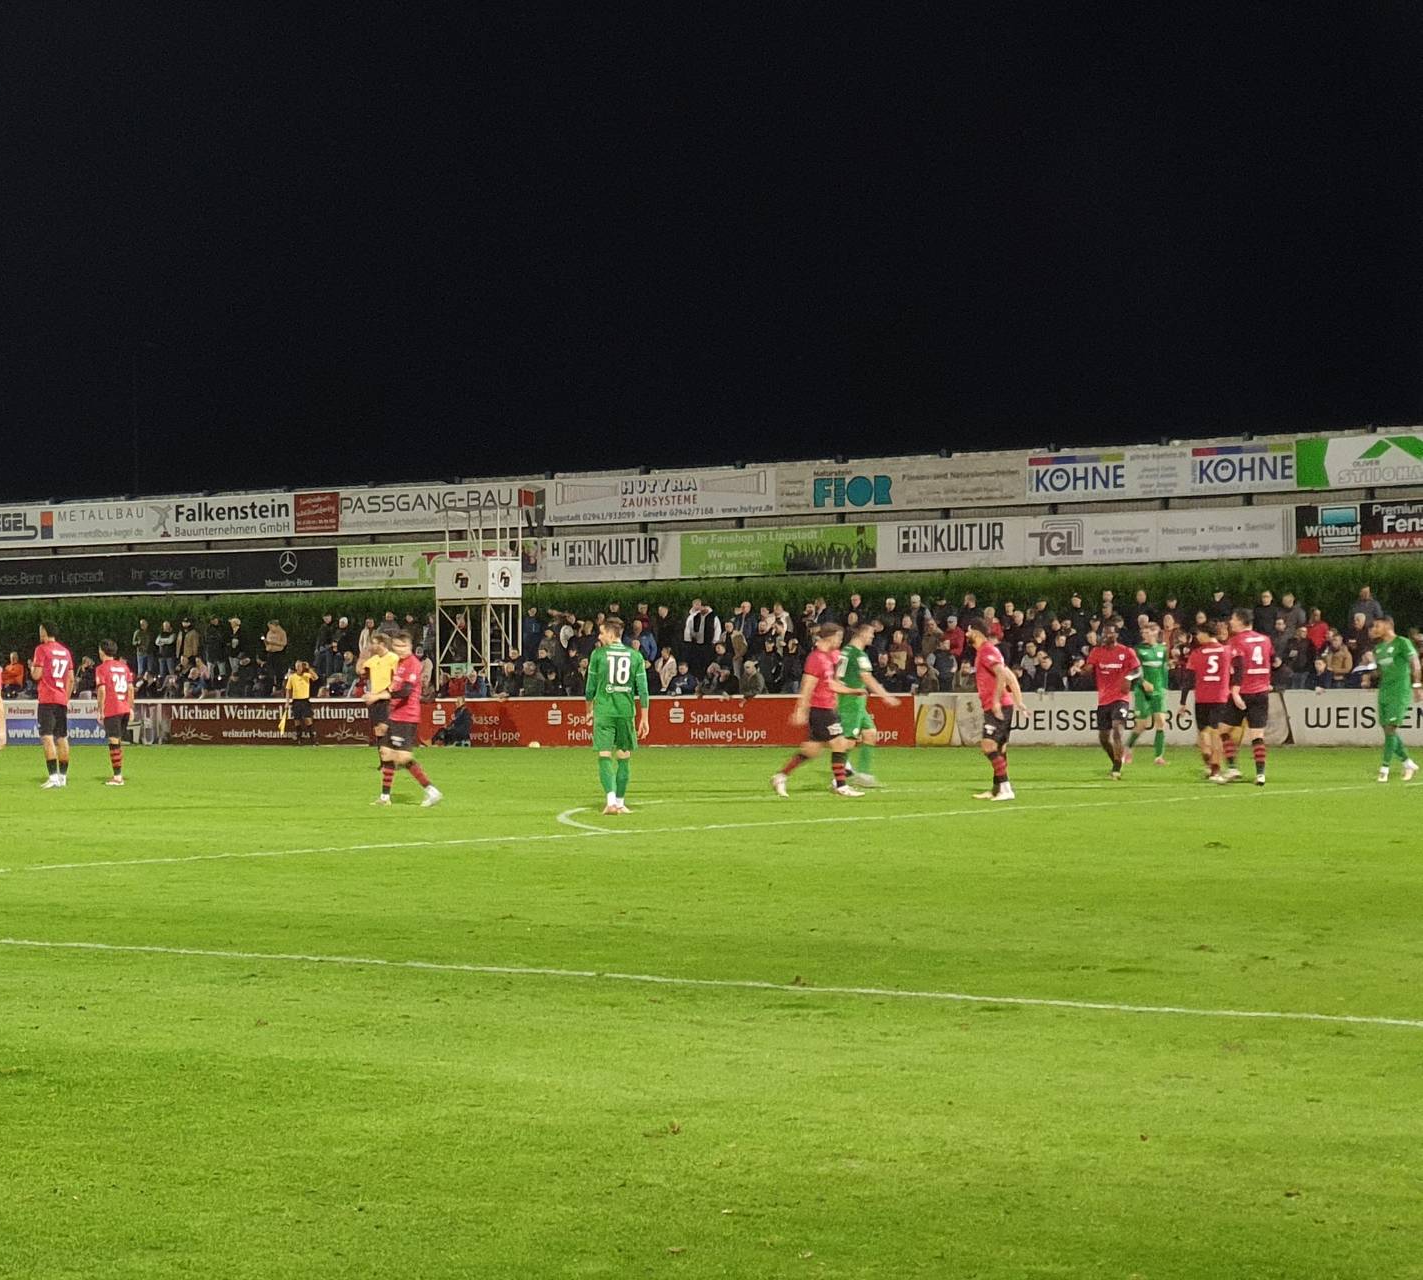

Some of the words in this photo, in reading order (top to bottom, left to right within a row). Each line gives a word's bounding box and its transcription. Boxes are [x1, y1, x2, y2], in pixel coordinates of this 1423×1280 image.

[1199, 455, 1293, 484] KÖHNE
[620, 477, 698, 495] HUTYRA
[1035, 465, 1126, 492] KÖHNE
[813, 475, 893, 508] FIOR
[340, 489, 512, 515] PASSGANG-BAU
[621, 494, 698, 507] ZAUNSYSTEME
[58, 507, 144, 521] METALLBAU
[174, 499, 290, 522] Falkenstein
[174, 524, 257, 537] Bauunternehmen
[259, 522, 291, 534] GmbH
[897, 522, 1004, 553] FANKULTUR
[1305, 523, 1361, 537] Witthaut
[691, 535, 708, 545] Der
[711, 533, 753, 546] Fanshop
[757, 532, 767, 542] in
[1028, 531, 1083, 556] TGL
[552, 542, 559, 557] H
[565, 537, 659, 566] FANKULTUR
[707, 549, 723, 559] Wir
[340, 555, 404, 568] BETTENWELT
[719, 561, 737, 571] Fan
[48, 572, 58, 584] in
[61, 569, 104, 585] Lippstadt
[1251, 646, 1263, 665] 4
[52, 658, 68, 678] 27
[607, 656, 631, 685] 18
[1206, 655, 1219, 674] 5
[171, 704, 220, 720] Michael
[690, 711, 744, 724] Sparkasse
[690, 727, 767, 741] Hellweg-Lippe
